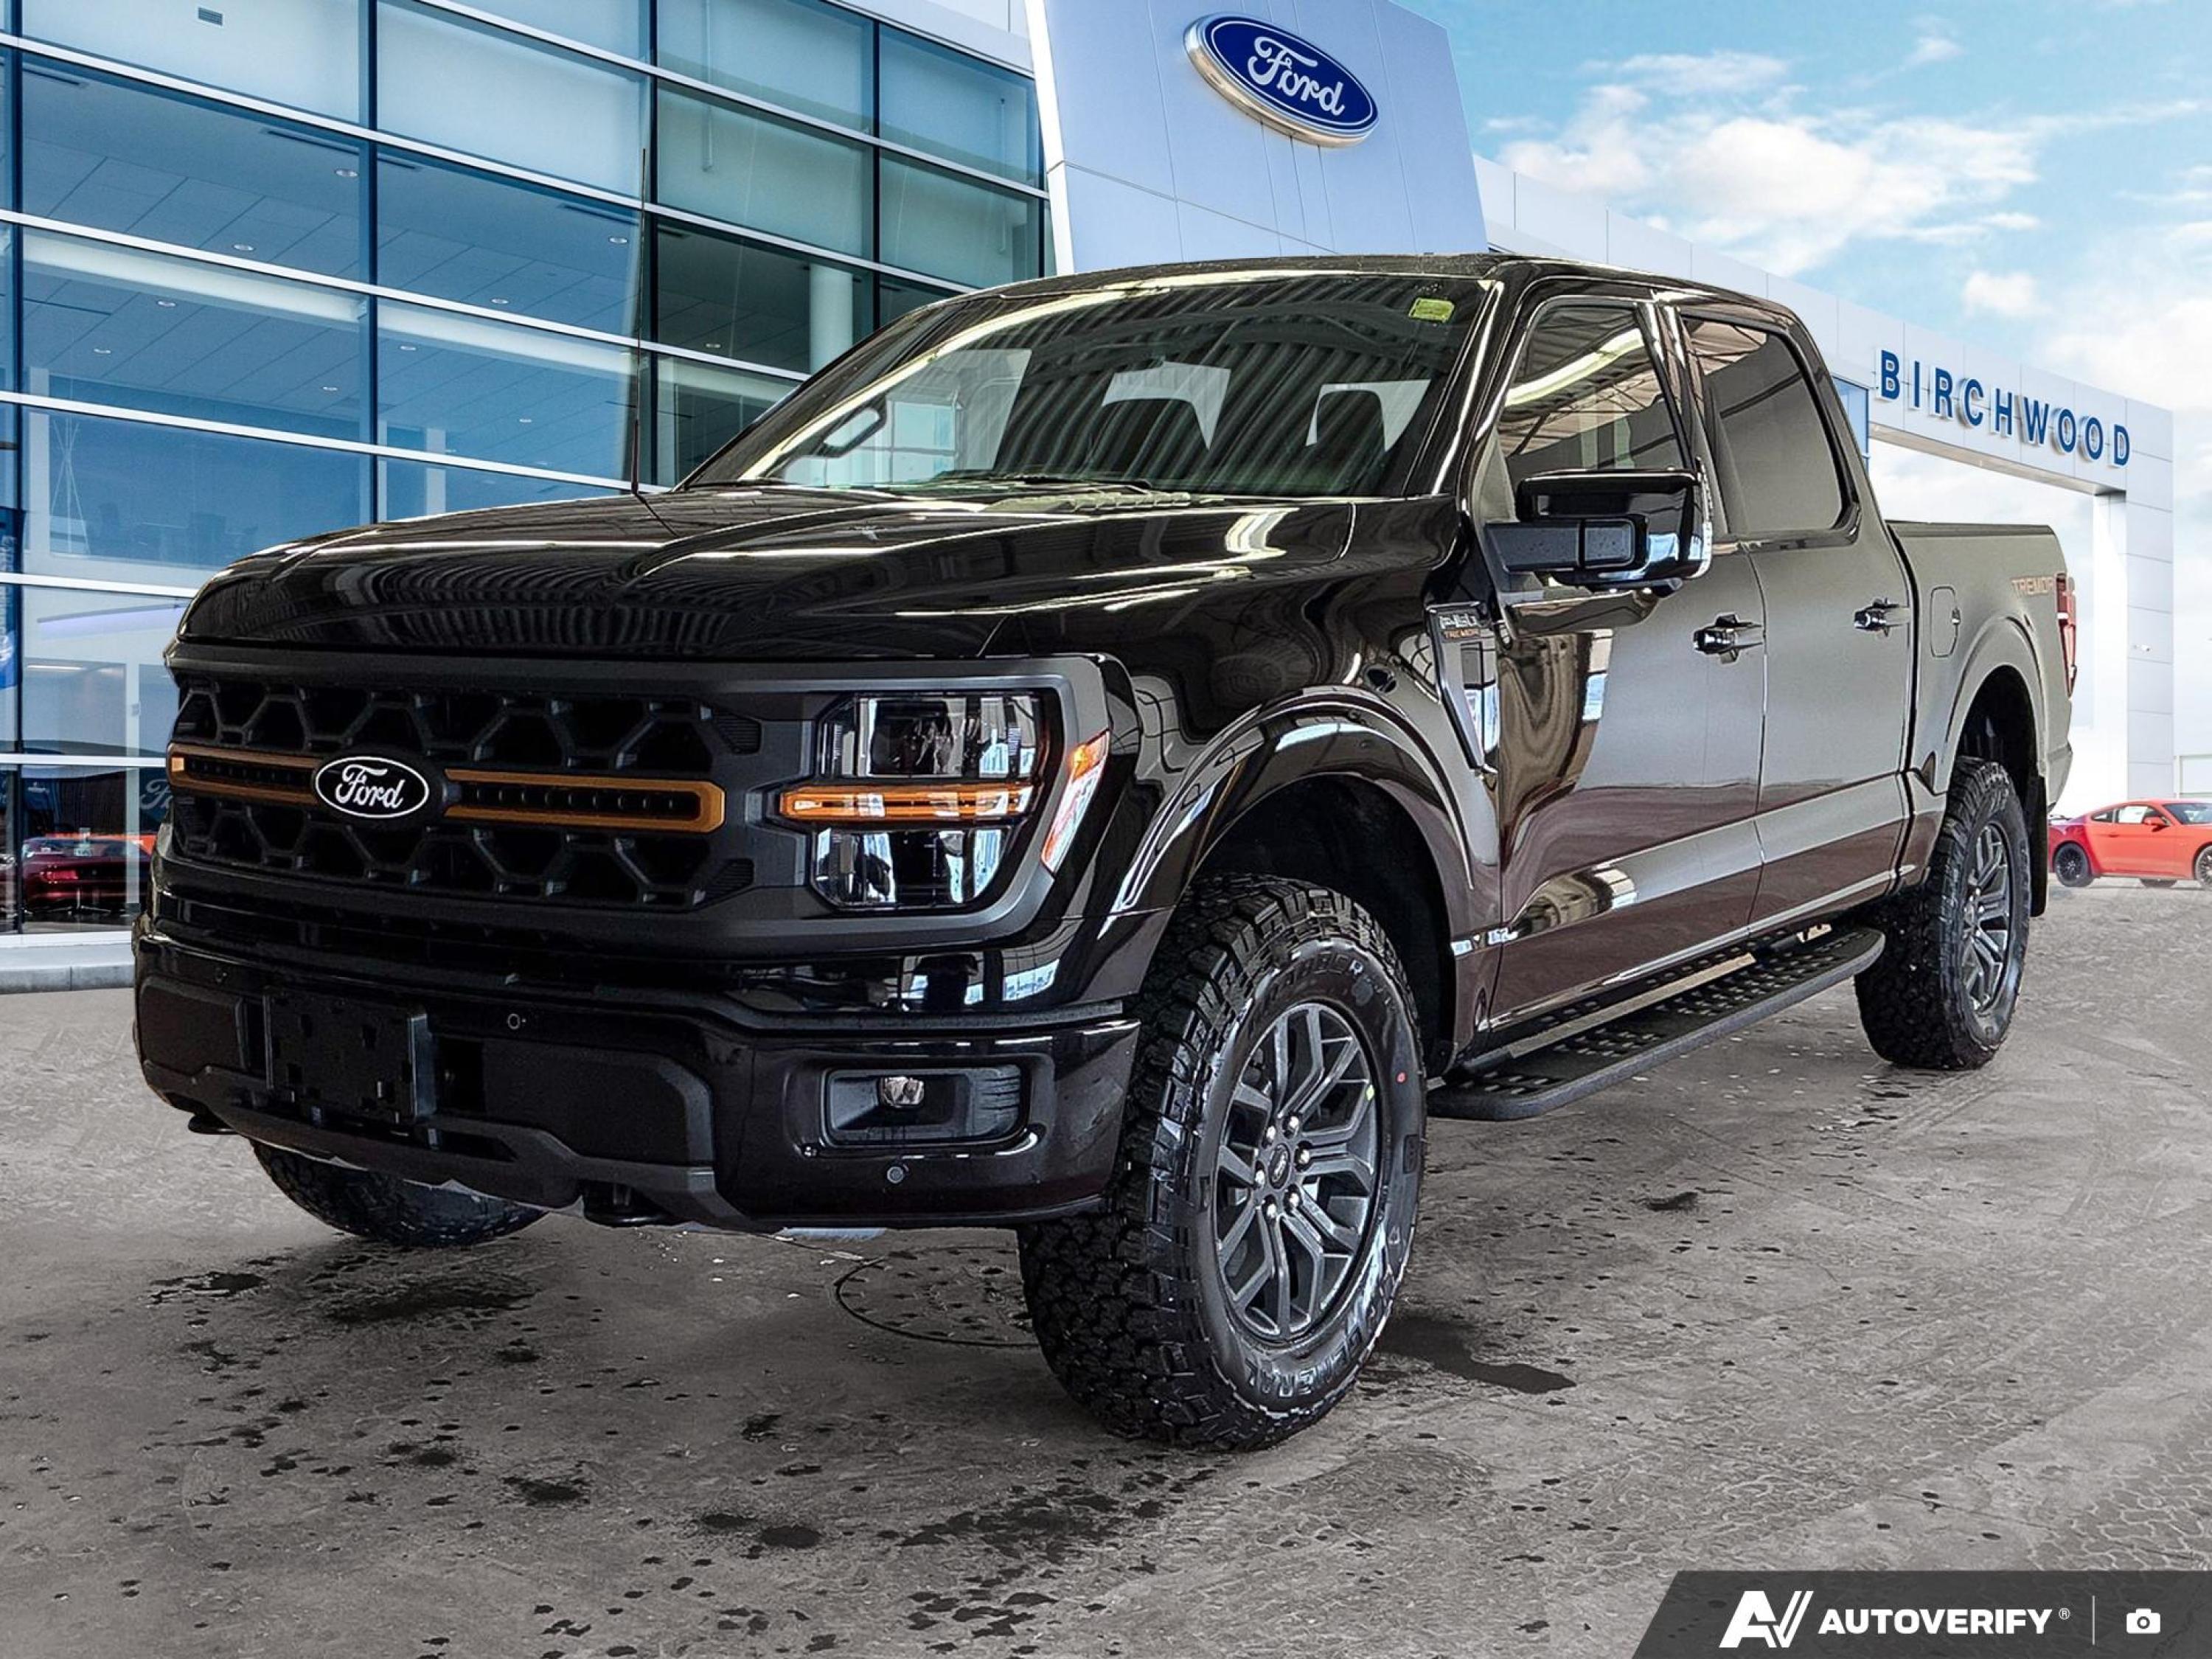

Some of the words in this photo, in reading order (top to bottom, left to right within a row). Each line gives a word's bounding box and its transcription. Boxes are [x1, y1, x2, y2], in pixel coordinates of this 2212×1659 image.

[1248, 36, 1345, 116] Ford
[1880, 349, 2130, 466] BIRCHWOOD
[335, 764, 406, 808] Ford
